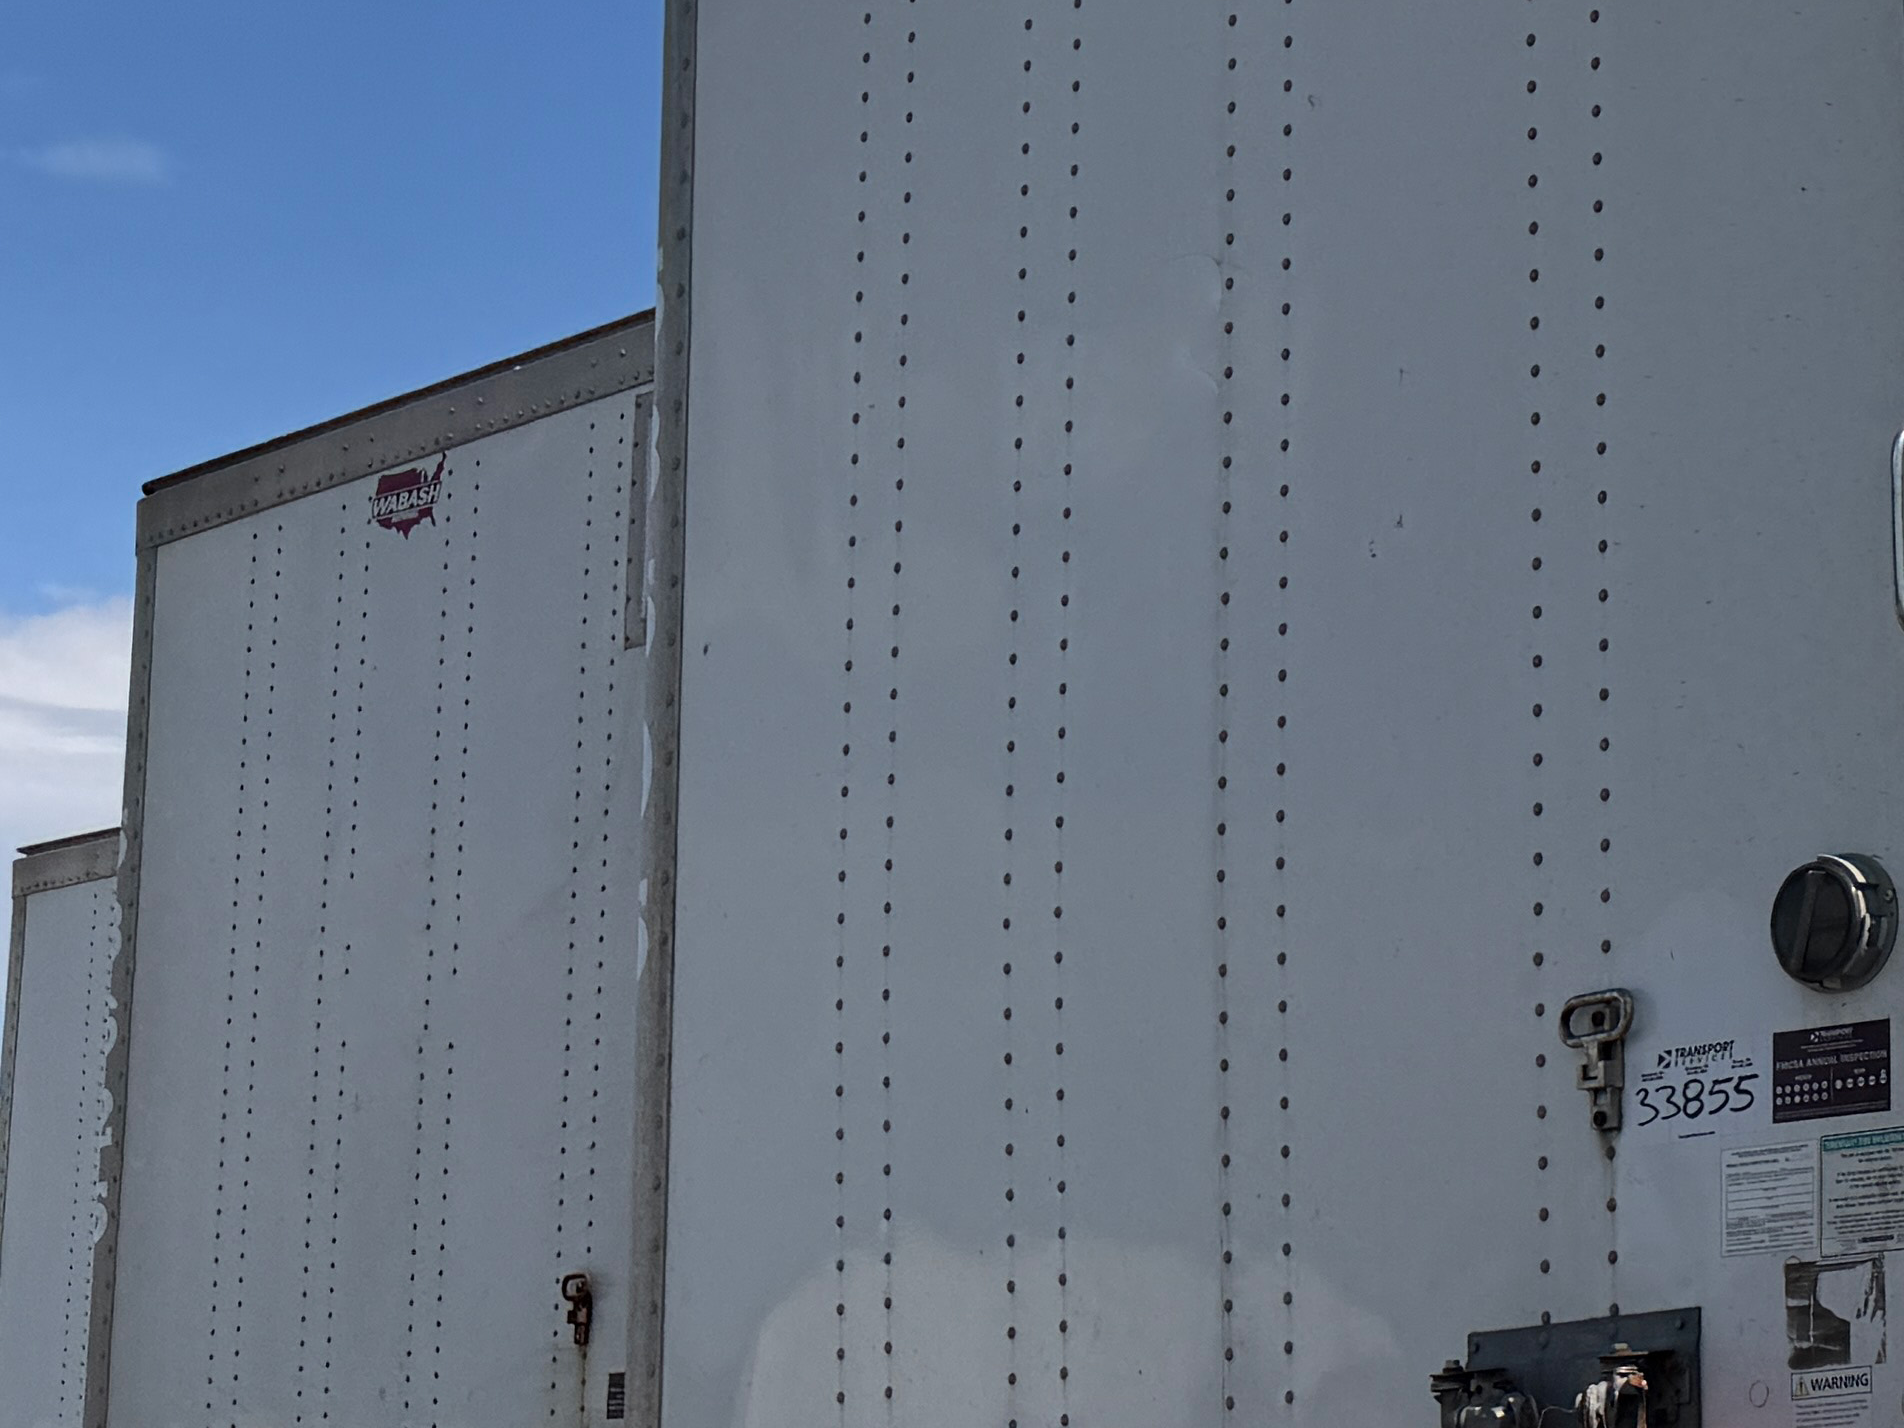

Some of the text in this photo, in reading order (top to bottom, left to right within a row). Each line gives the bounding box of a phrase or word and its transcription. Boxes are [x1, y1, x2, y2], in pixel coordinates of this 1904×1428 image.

[373, 483, 440, 517] WABASH
[1674, 1039, 1735, 1058] TRANSPORT
[1635, 1072, 1760, 1127] 33855
[1810, 1372, 1869, 1392] WARNING
